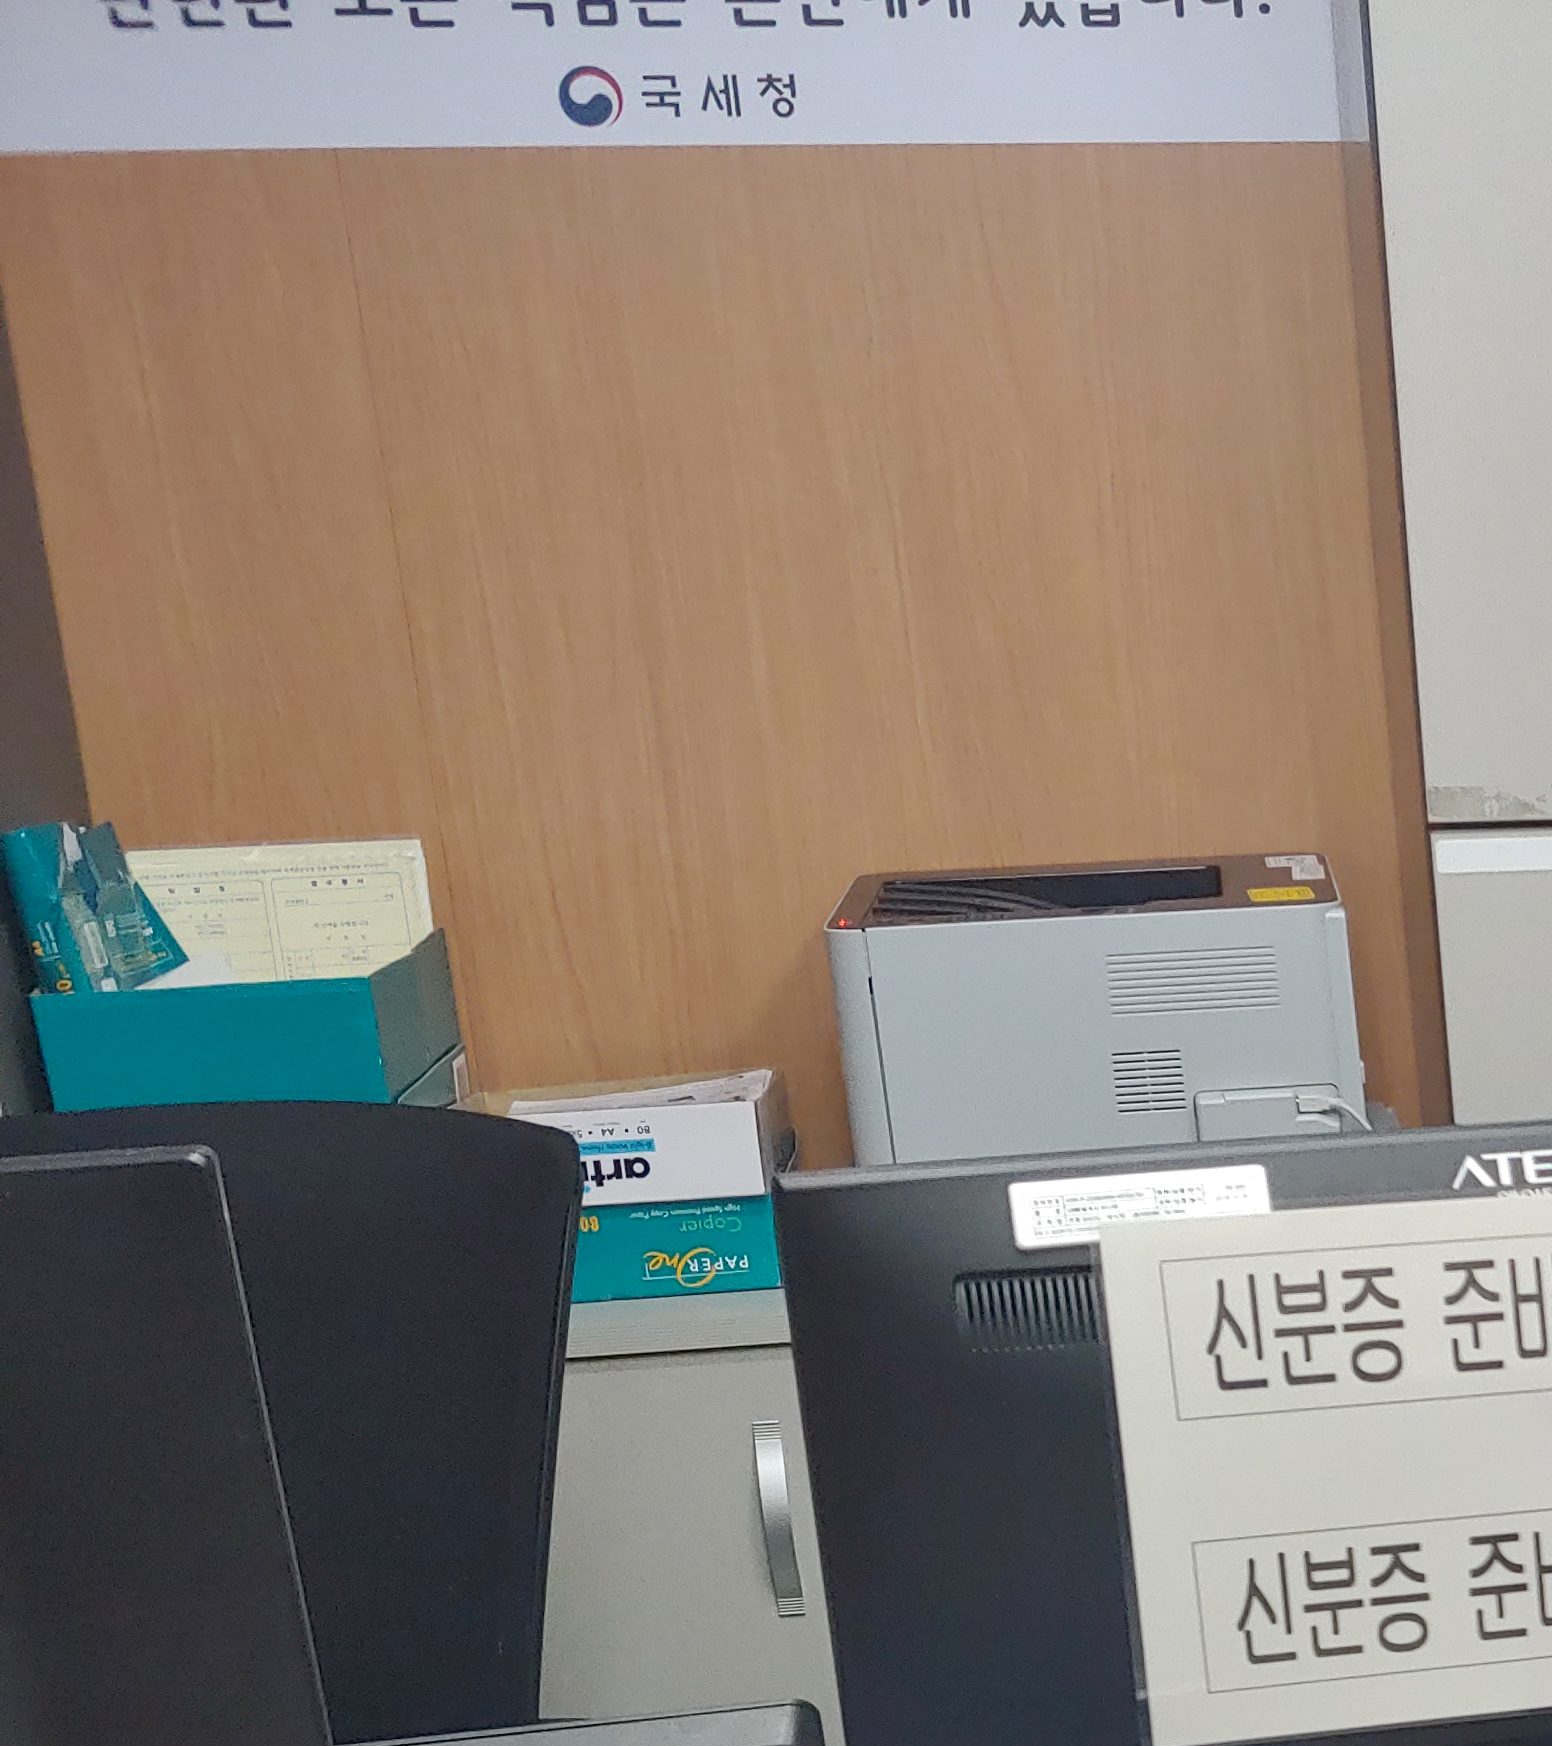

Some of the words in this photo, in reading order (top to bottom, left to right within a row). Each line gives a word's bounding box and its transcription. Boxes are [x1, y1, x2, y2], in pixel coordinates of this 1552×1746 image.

[641, 74, 798, 119] 국세청
[679, 1214, 742, 1234] Copier
[1206, 1265, 1405, 1391] 신분증
[1237, 1542, 1430, 1664] 신분증
